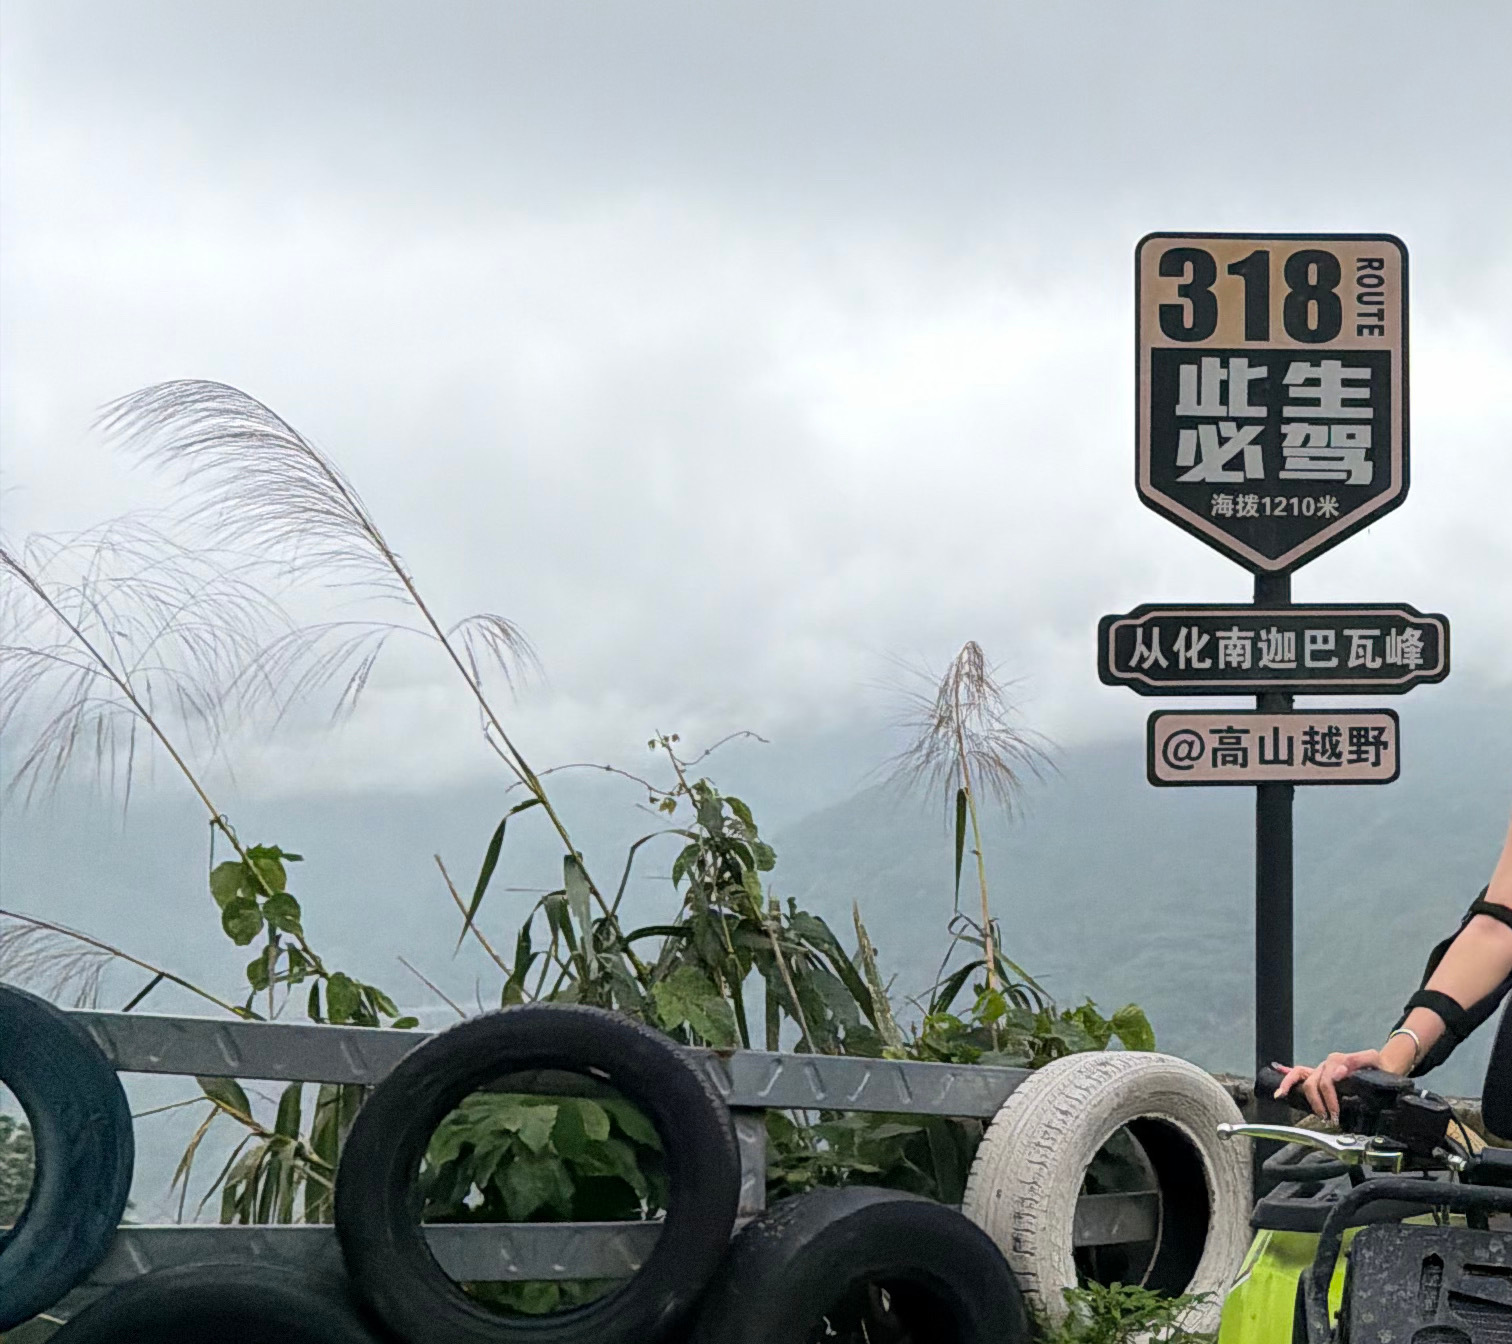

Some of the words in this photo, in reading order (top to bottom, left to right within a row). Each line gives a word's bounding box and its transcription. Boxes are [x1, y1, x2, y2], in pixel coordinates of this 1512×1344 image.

[1158, 247, 1343, 344] 318
[1356, 257, 1385, 337] ROUTE
[1175, 357, 1374, 419] 此生
[1175, 421, 1374, 485] 必驾
[1128, 626, 1425, 671] 从化南迦巴瓦峰
[1162, 724, 1390, 770] @高山越野
